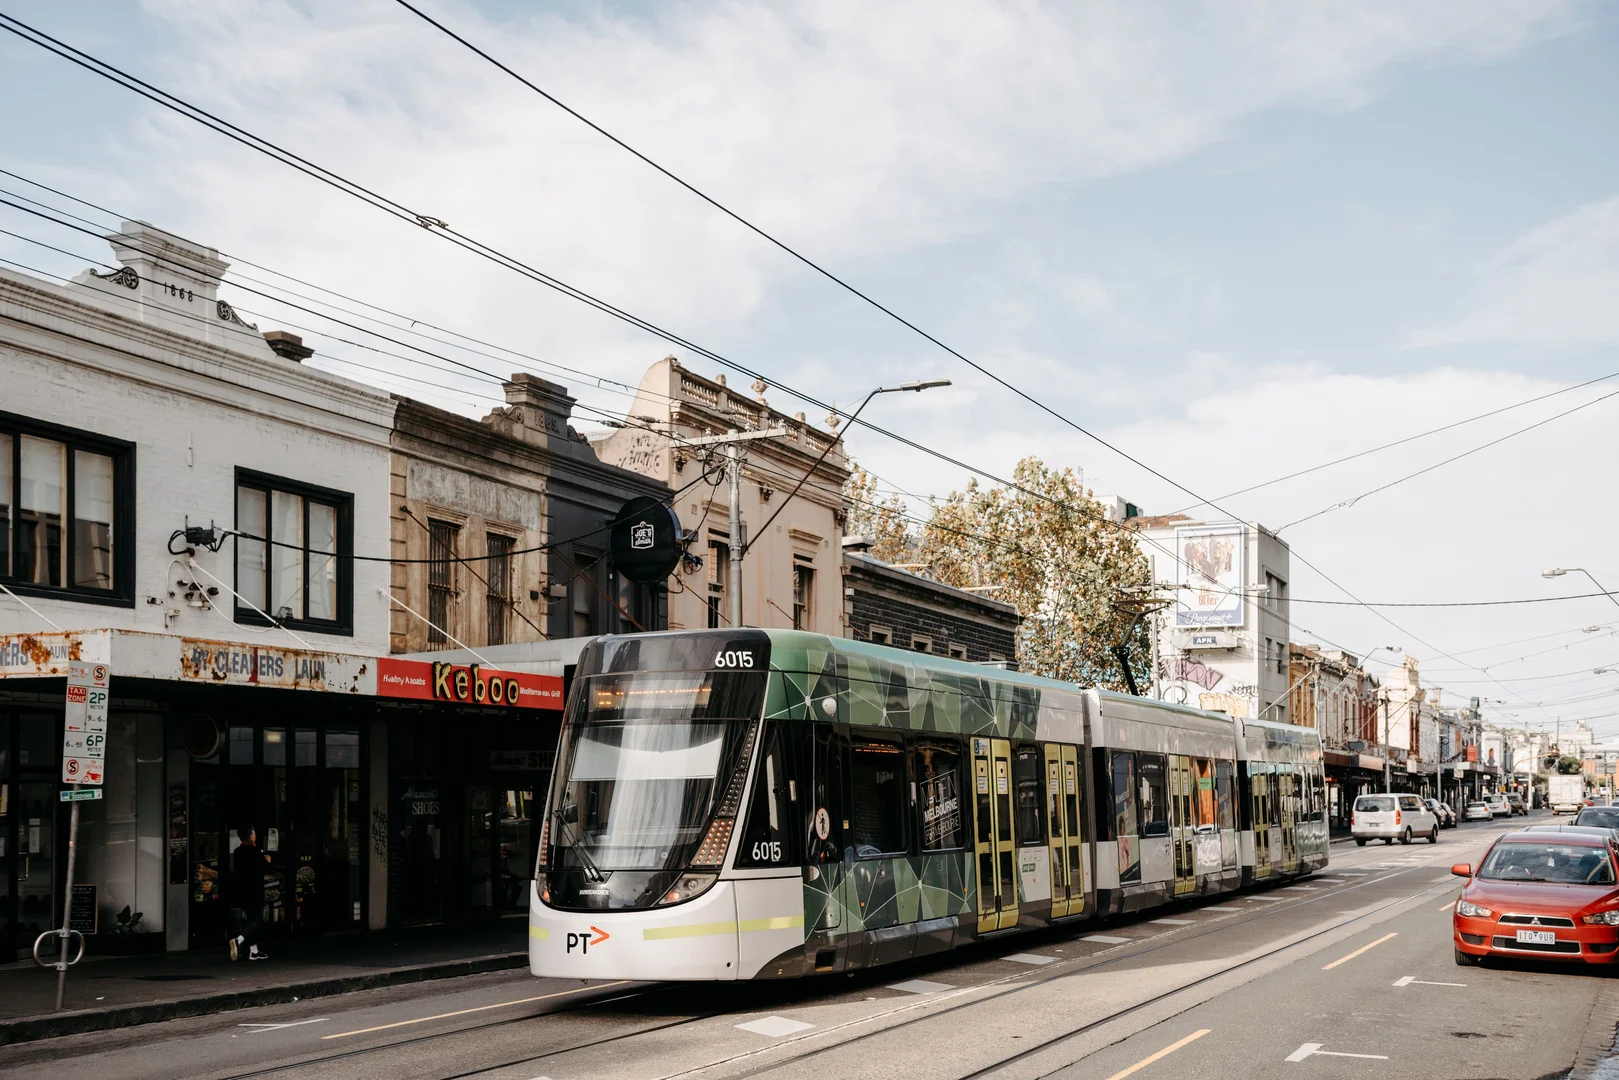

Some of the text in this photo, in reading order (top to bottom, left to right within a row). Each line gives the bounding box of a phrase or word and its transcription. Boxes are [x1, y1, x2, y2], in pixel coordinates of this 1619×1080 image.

[164, 282, 194, 302] 1868
[714, 650, 754, 668] 6015
[433, 661, 520, 705] Keboo
[68, 694, 86, 702] ZONE
[89, 692, 106, 704] 2P
[86, 735, 104, 747] 6P
[411, 801, 440, 816] SHOES
[924, 797, 958, 823] MELBOURNE
[752, 841, 781, 861] 6015
